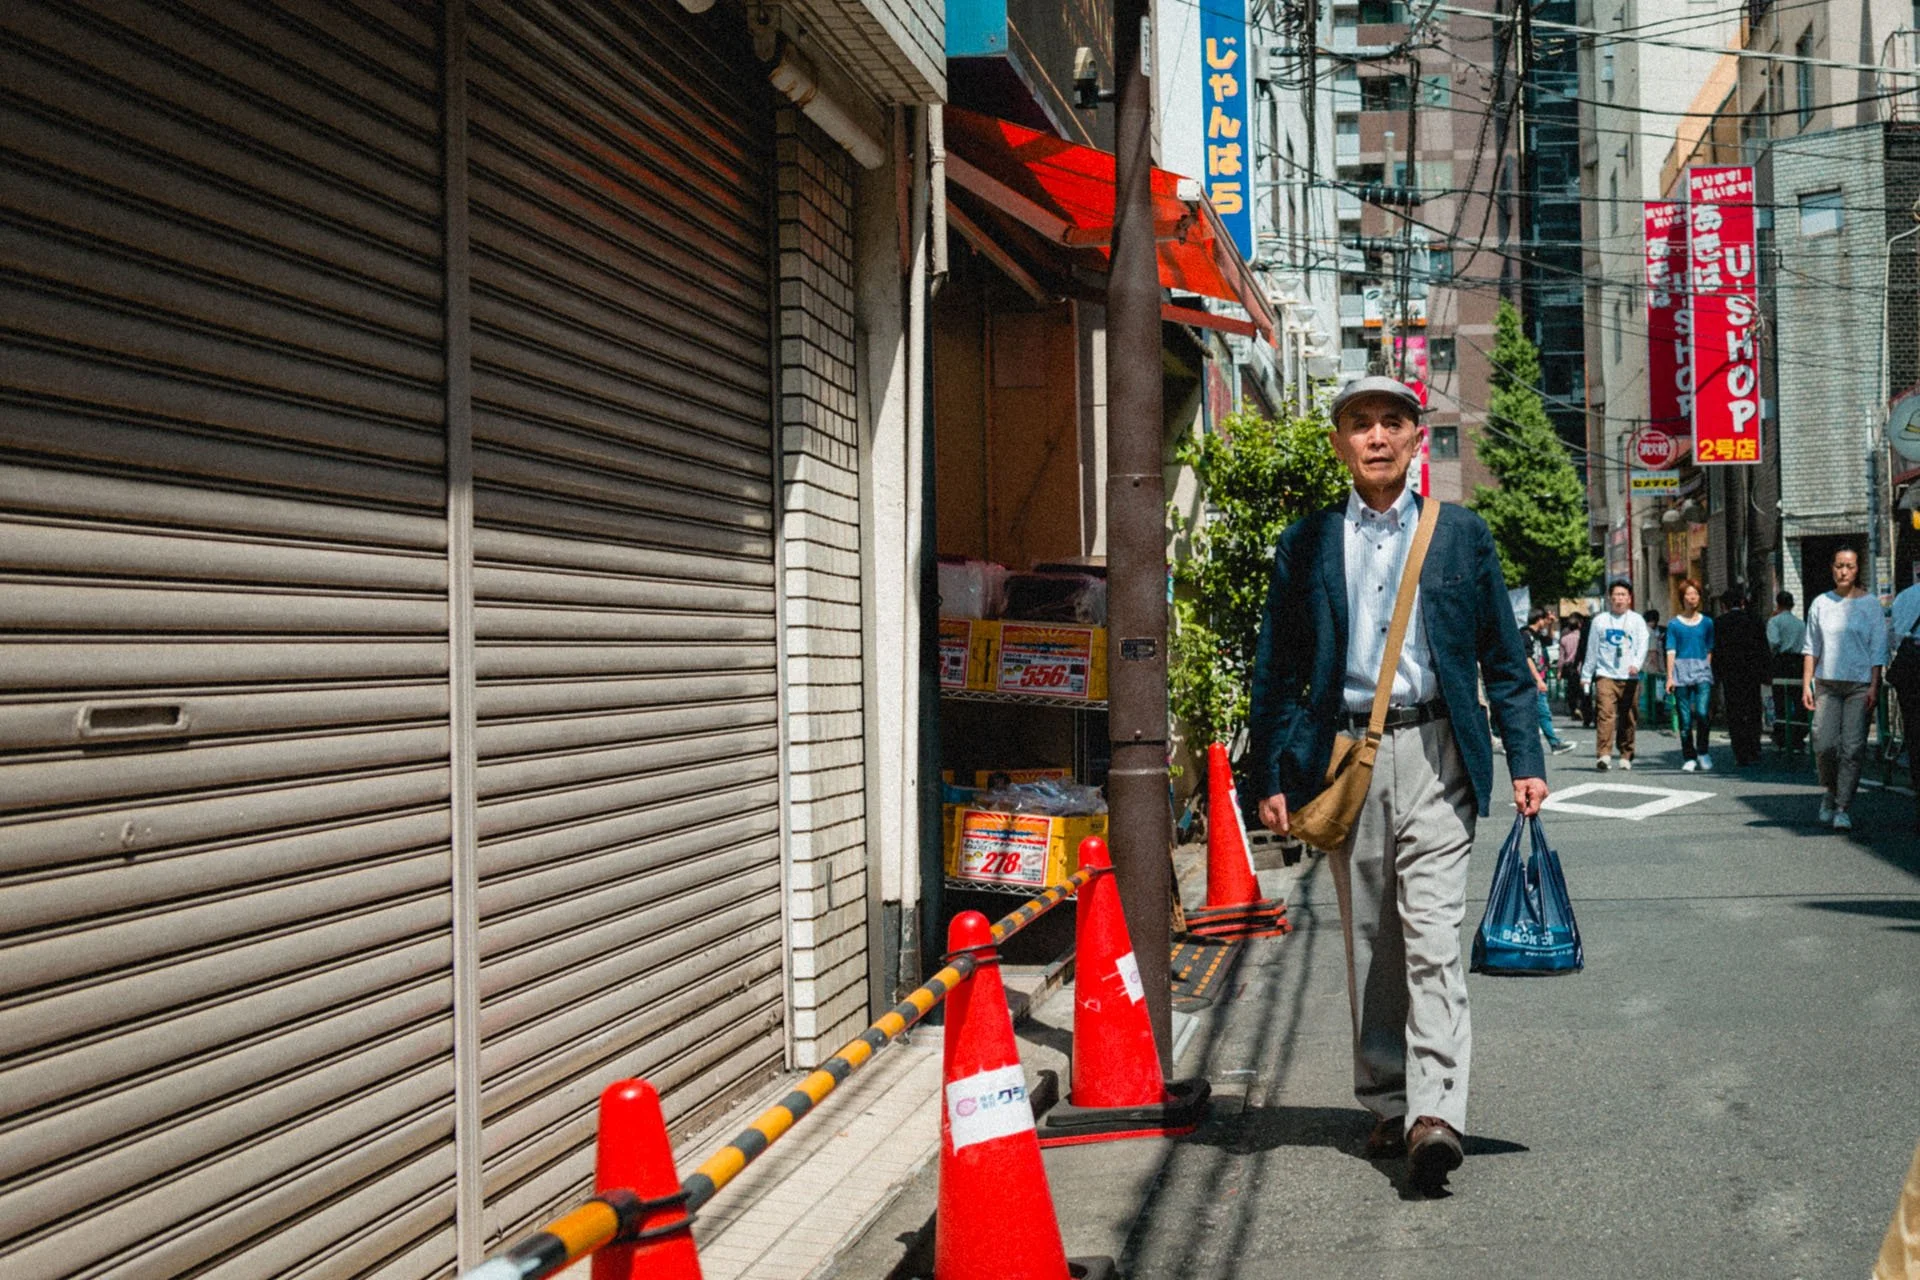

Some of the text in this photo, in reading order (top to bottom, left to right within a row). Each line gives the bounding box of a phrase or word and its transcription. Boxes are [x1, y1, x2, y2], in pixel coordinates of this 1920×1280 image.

[1724, 243, 1757, 433] U-SHOP
[1699, 438, 1757, 461] 2号店
[1020, 664, 1068, 688] 556
[980, 851, 1021, 875] 278
